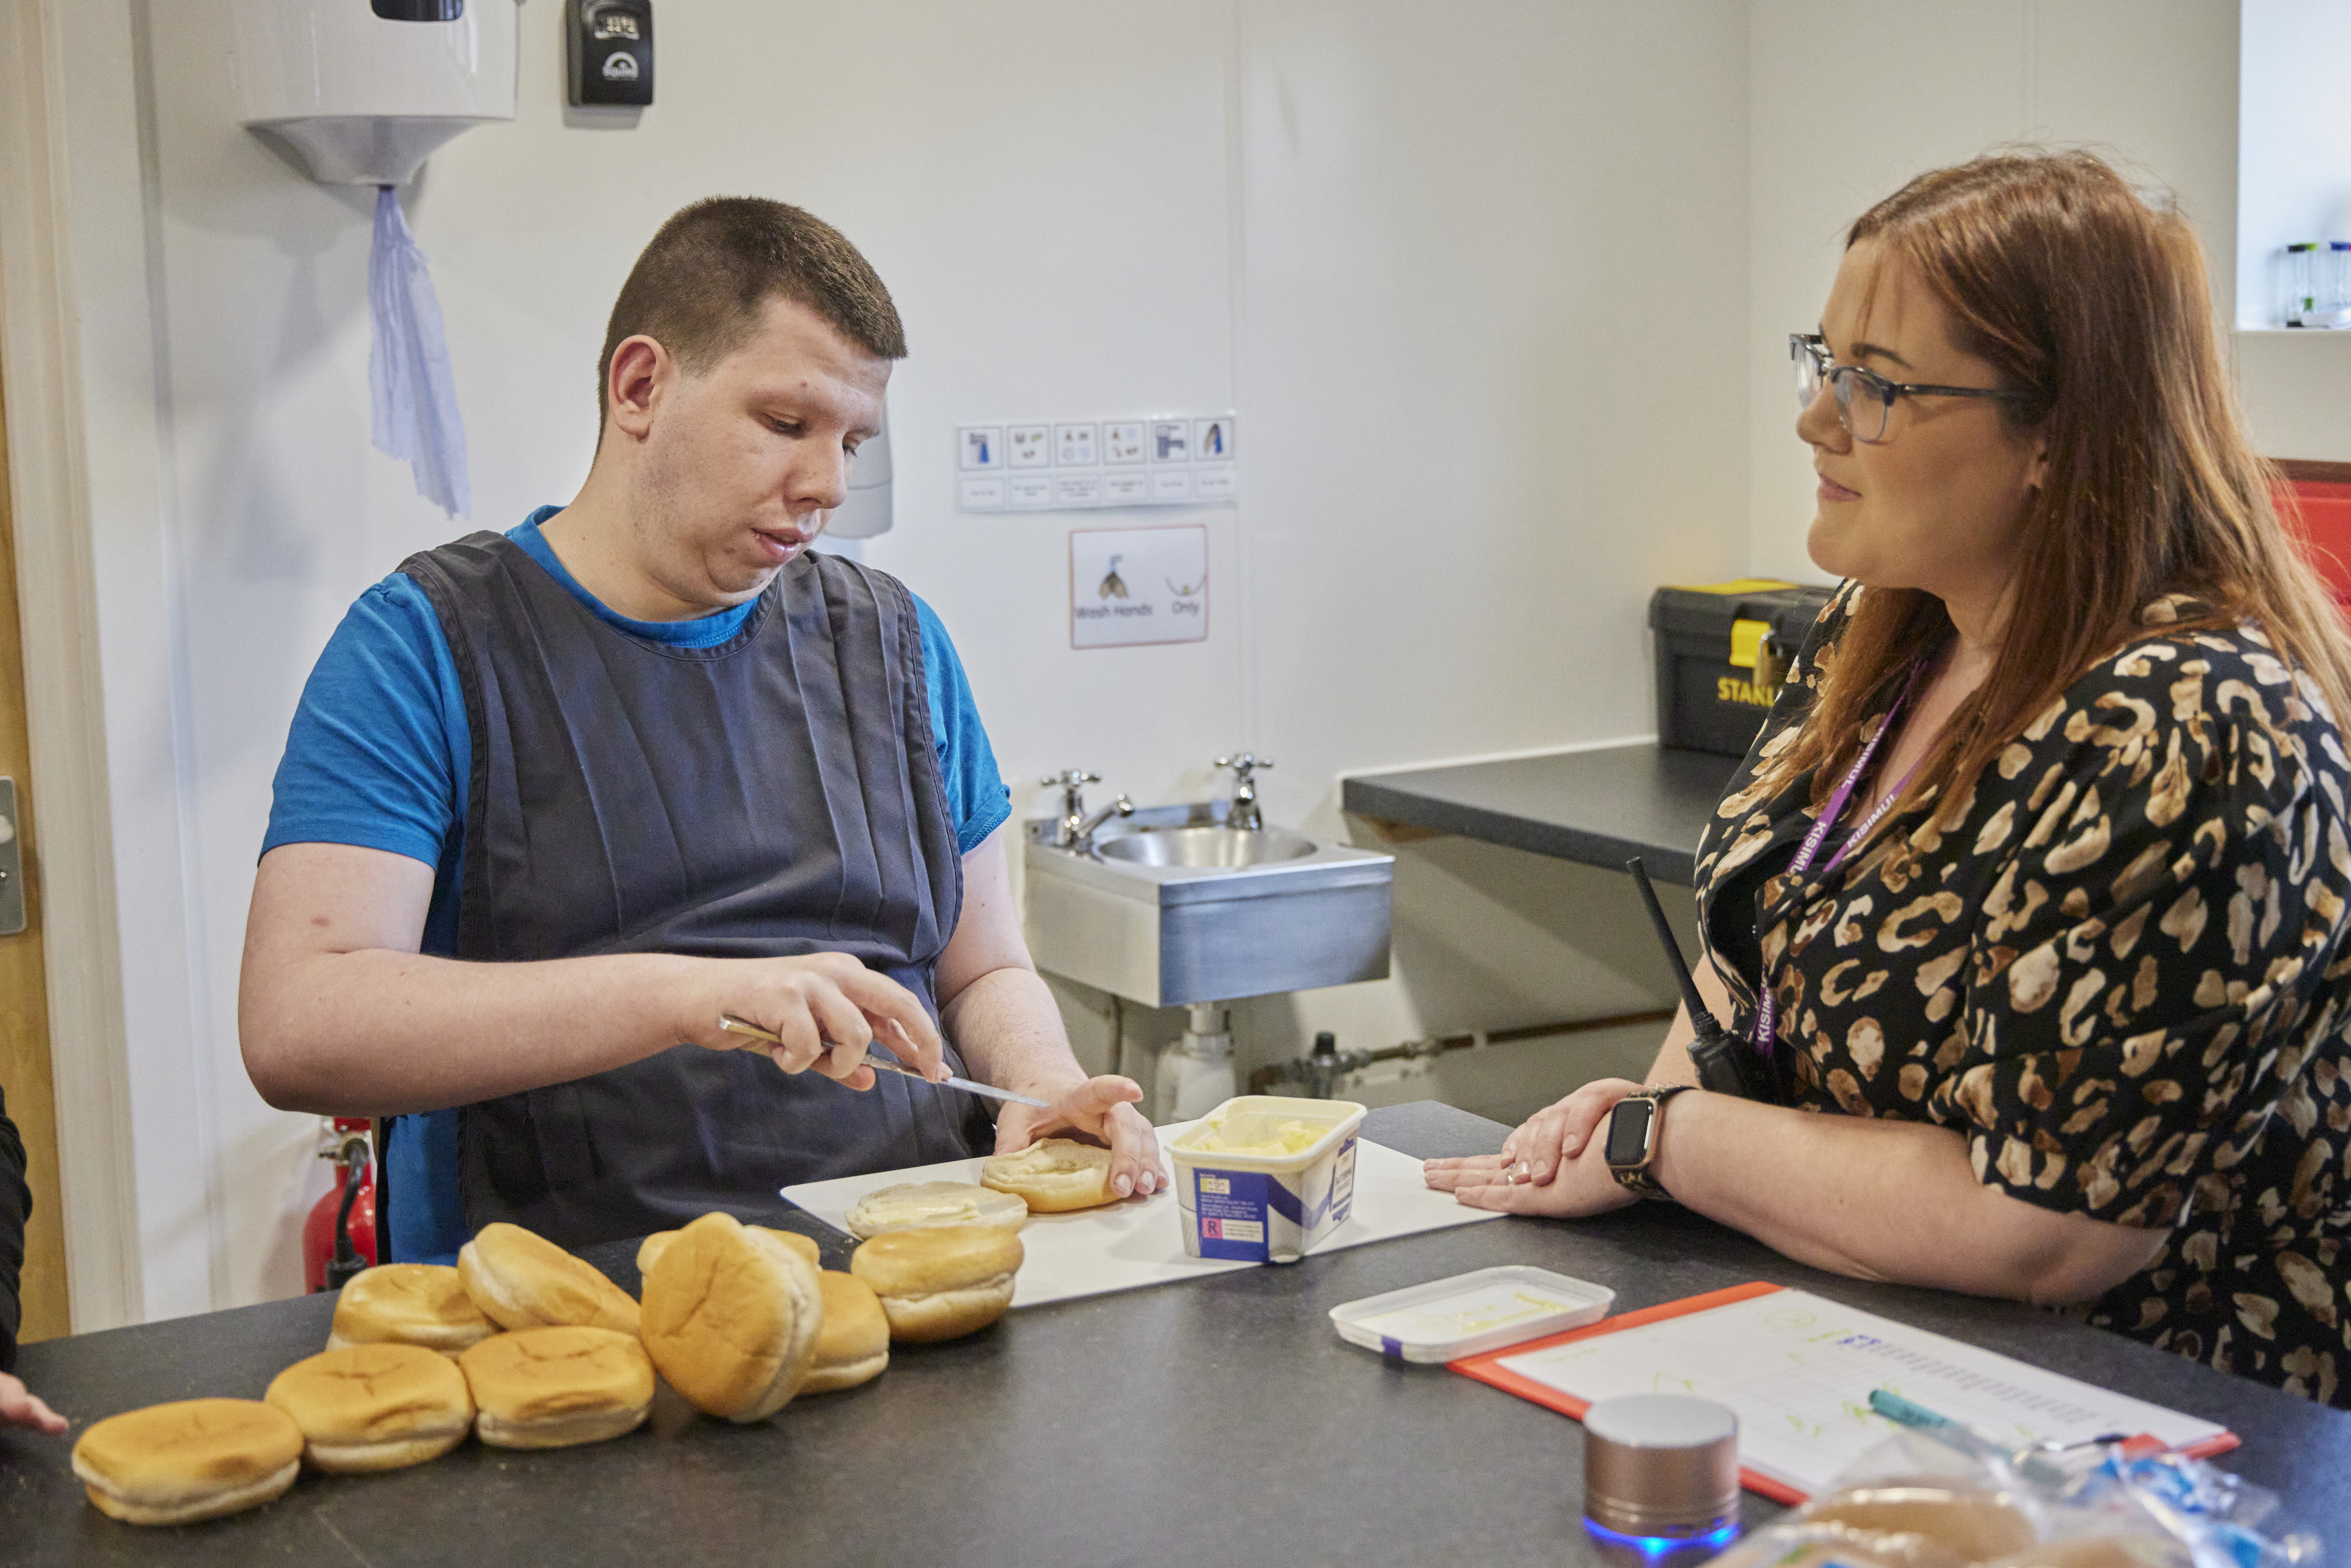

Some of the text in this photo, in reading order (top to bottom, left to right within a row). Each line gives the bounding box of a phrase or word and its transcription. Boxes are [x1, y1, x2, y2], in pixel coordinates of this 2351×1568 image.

[1076, 601, 1199, 619] Wash Hands Only
[1717, 676, 1781, 707] STANL
